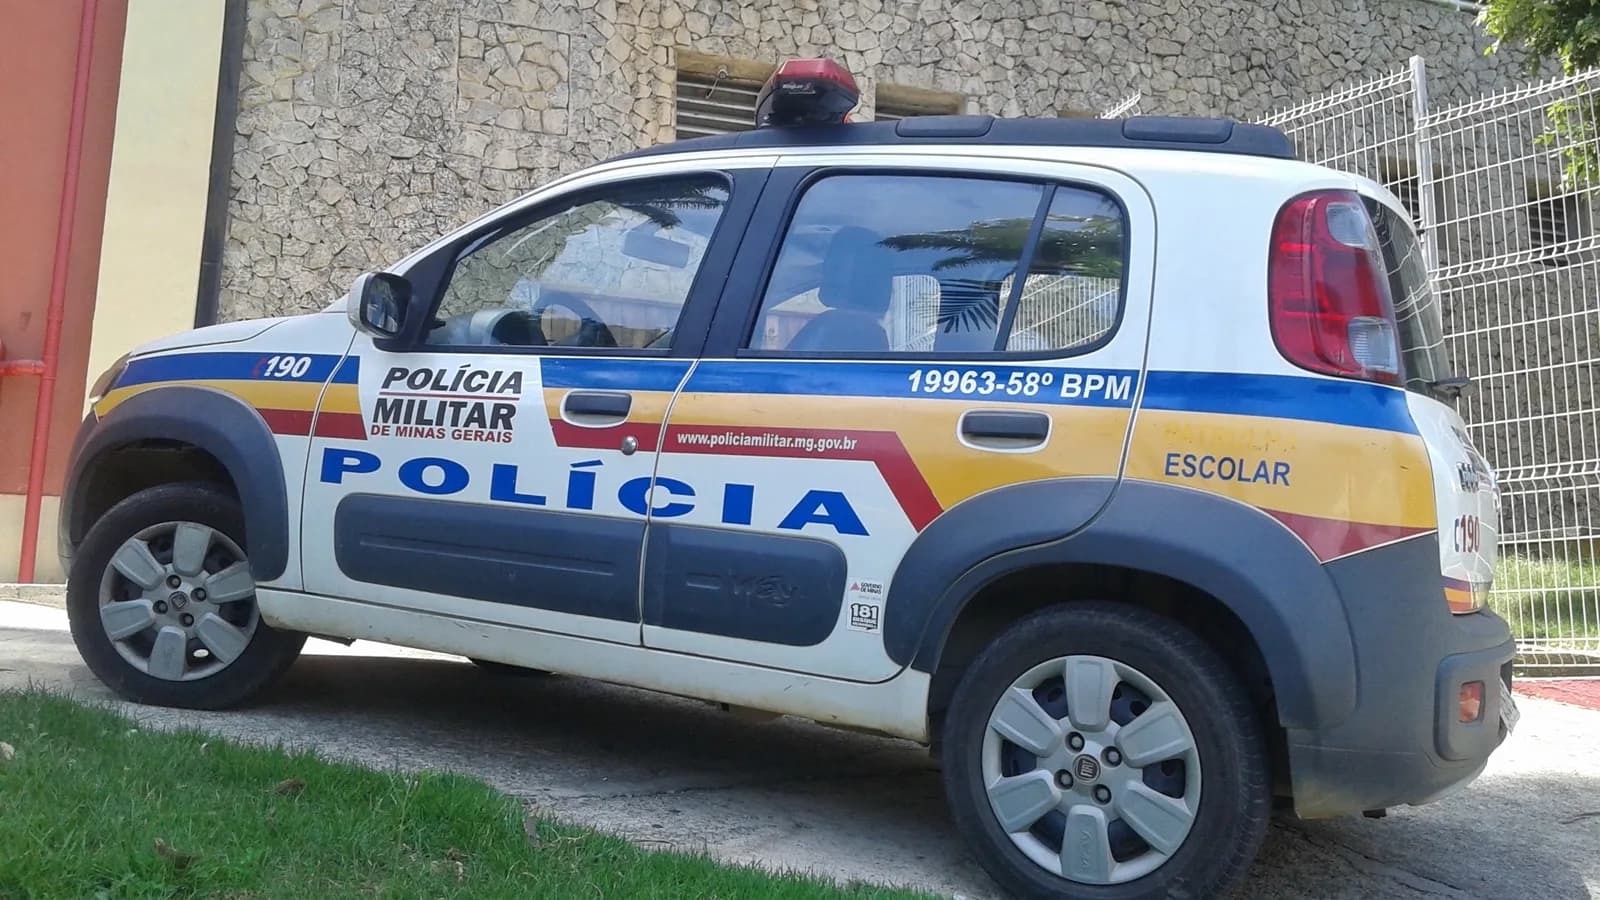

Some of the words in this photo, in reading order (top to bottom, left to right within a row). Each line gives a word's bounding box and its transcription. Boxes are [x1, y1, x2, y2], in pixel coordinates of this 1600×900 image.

[264, 355, 312, 378] 190
[381, 363, 523, 395] POLÍCIA
[1060, 373, 1132, 400] BPM
[372, 398, 517, 430] MILITAR
[370, 425, 391, 436] DE
[395, 426, 446, 440] MINAS
[451, 429, 513, 443] GERAIS
[677, 432, 858, 452] www.policiamilitar.mg.gov.br
[1164, 452, 1291, 487] ESCOLAR
[319, 447, 871, 537] POLÍCIA
[1460, 514, 1480, 553] 190
[850, 603, 879, 619] 181
